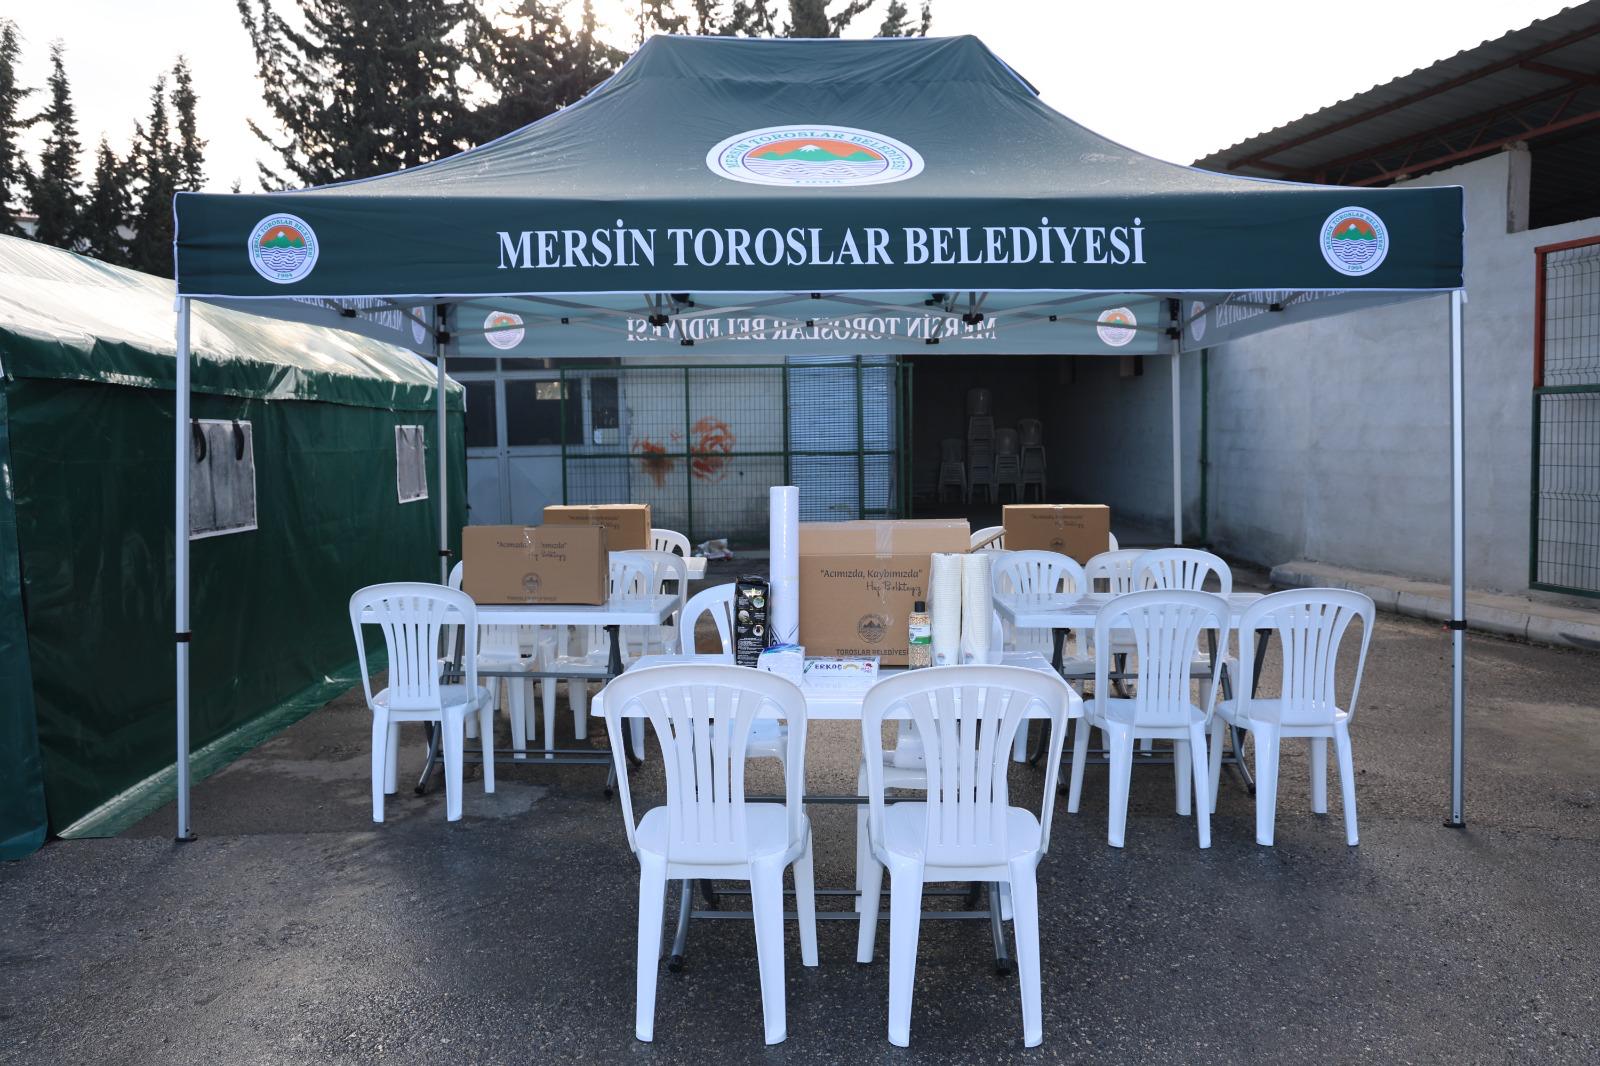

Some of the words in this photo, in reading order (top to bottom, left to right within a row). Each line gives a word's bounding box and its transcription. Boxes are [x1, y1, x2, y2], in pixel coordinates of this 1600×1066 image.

[749, 131, 845, 145] TOROSLAR
[496, 218, 657, 269] MERSİN
[667, 227, 895, 267] TOROSLAR
[902, 216, 1147, 265] BELEDİYESİ
[836, 648, 871, 656] TOROSLAR
